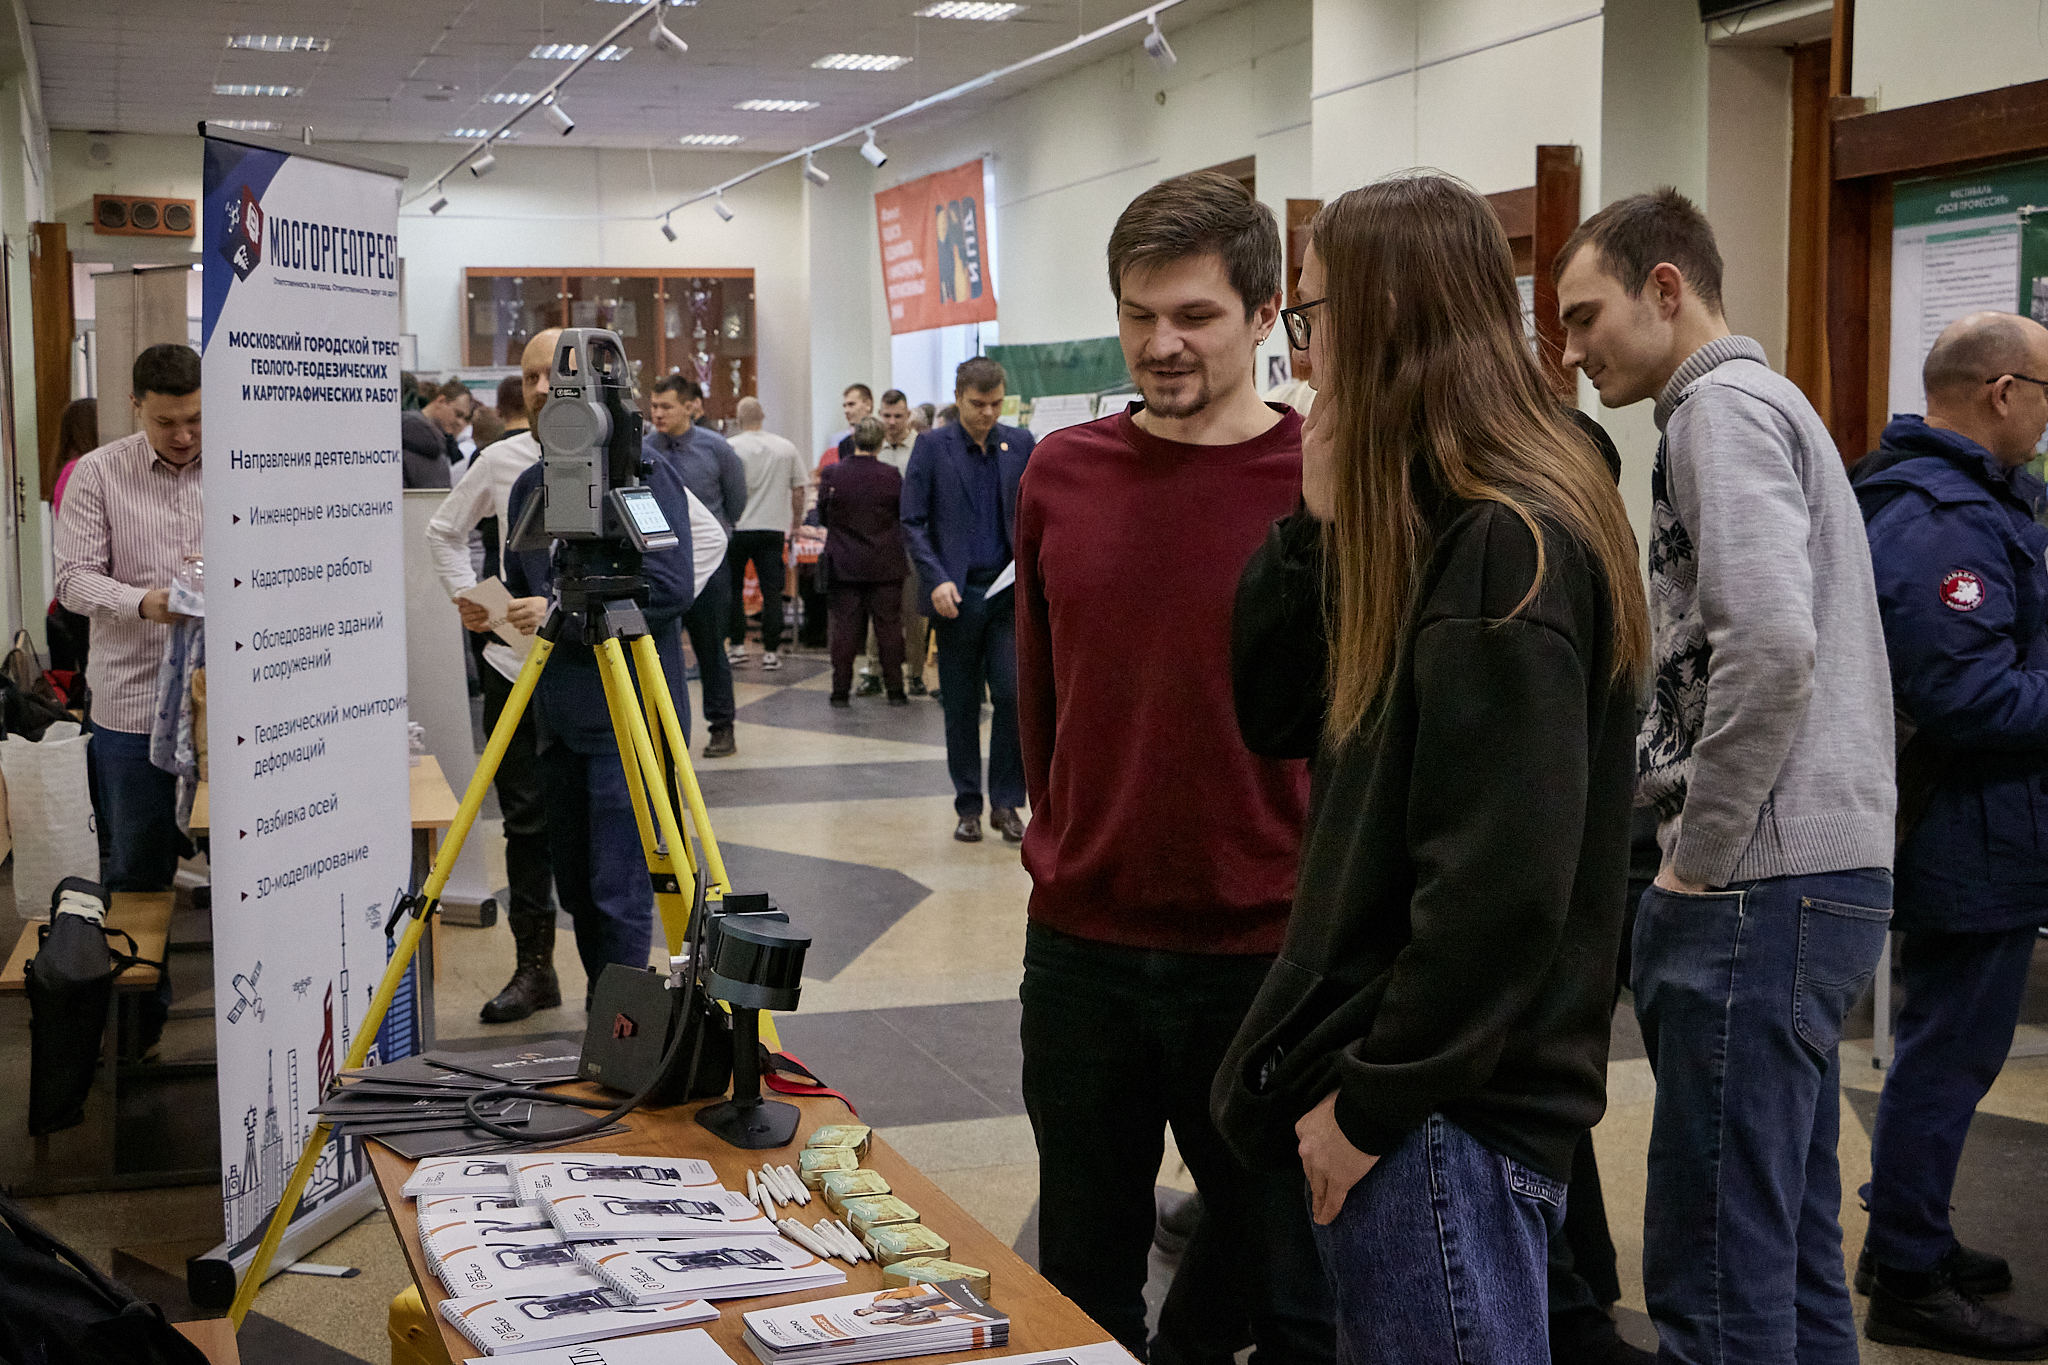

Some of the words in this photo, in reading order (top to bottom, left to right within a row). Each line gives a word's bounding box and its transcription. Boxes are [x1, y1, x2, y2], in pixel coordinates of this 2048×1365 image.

[229, 331, 302, 352] МОСКОВСКИЙ
[304, 336, 369, 356] ГОРОДСКОЙ
[251, 358, 388, 380] ГЕОЛОГО-ГЕОДЕЗИЧЕСКИХ
[242, 384, 251, 401] И
[253, 385, 363, 402] КАРТОГРАФИЧЕСКИХ
[365, 388, 398, 403] РАБОТ
[231, 450, 311, 473] Направления
[250, 505, 323, 527] Инженерные
[326, 500, 394, 519] изыскания
[251, 565, 323, 590] Кадастровые
[326, 556, 373, 583] работы
[252, 621, 335, 652] Обследование
[337, 610, 384, 636] зданий
[253, 667, 261, 683] и
[262, 647, 331, 681] сооружений
[255, 705, 339, 744] Геодезический
[254, 737, 326, 779] деформаций
[257, 809, 306, 838] Разбивка
[308, 792, 338, 819] осей
[256, 845, 369, 900] 3D-моделирование
[465, 1272, 478, 1283] EFT
[470, 1263, 487, 1281] GROUP
[490, 1325, 506, 1335] EFT
[494, 1316, 516, 1333] GROUP
